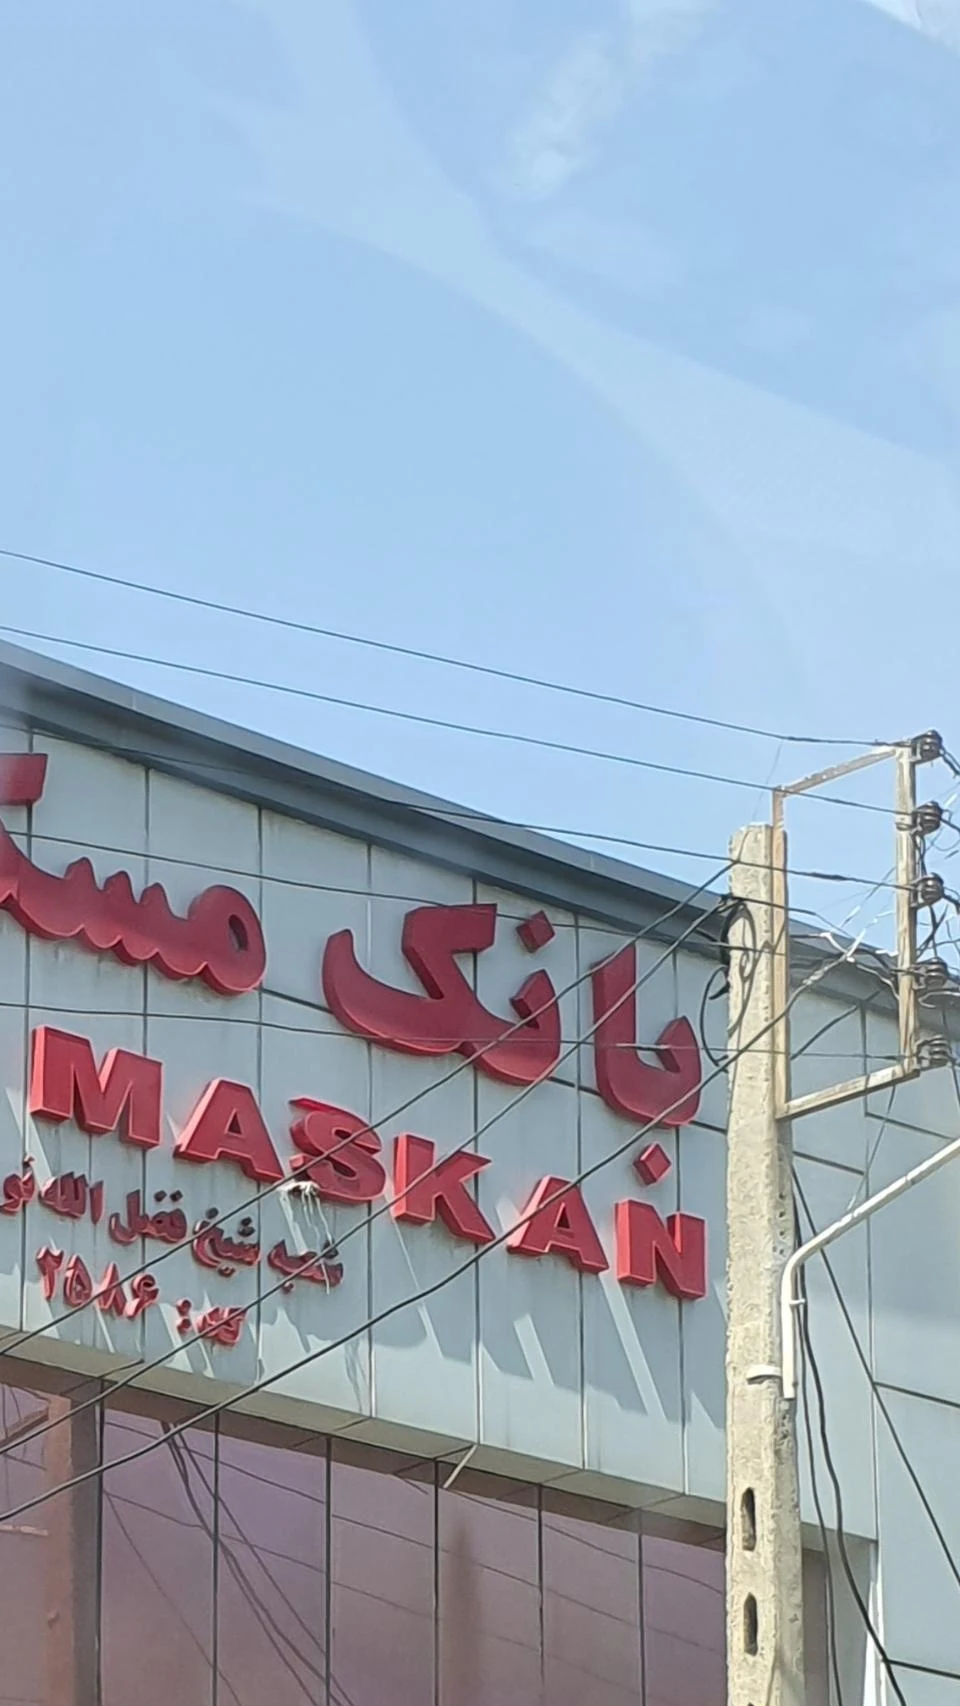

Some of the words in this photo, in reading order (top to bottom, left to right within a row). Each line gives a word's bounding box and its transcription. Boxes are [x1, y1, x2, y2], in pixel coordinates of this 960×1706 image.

[322, 902, 703, 1186] بانک
[28, 1025, 707, 1301] MASKAN
[107, 1187, 189, 1245] فضل
[191, 1205, 262, 1278] شیخ
